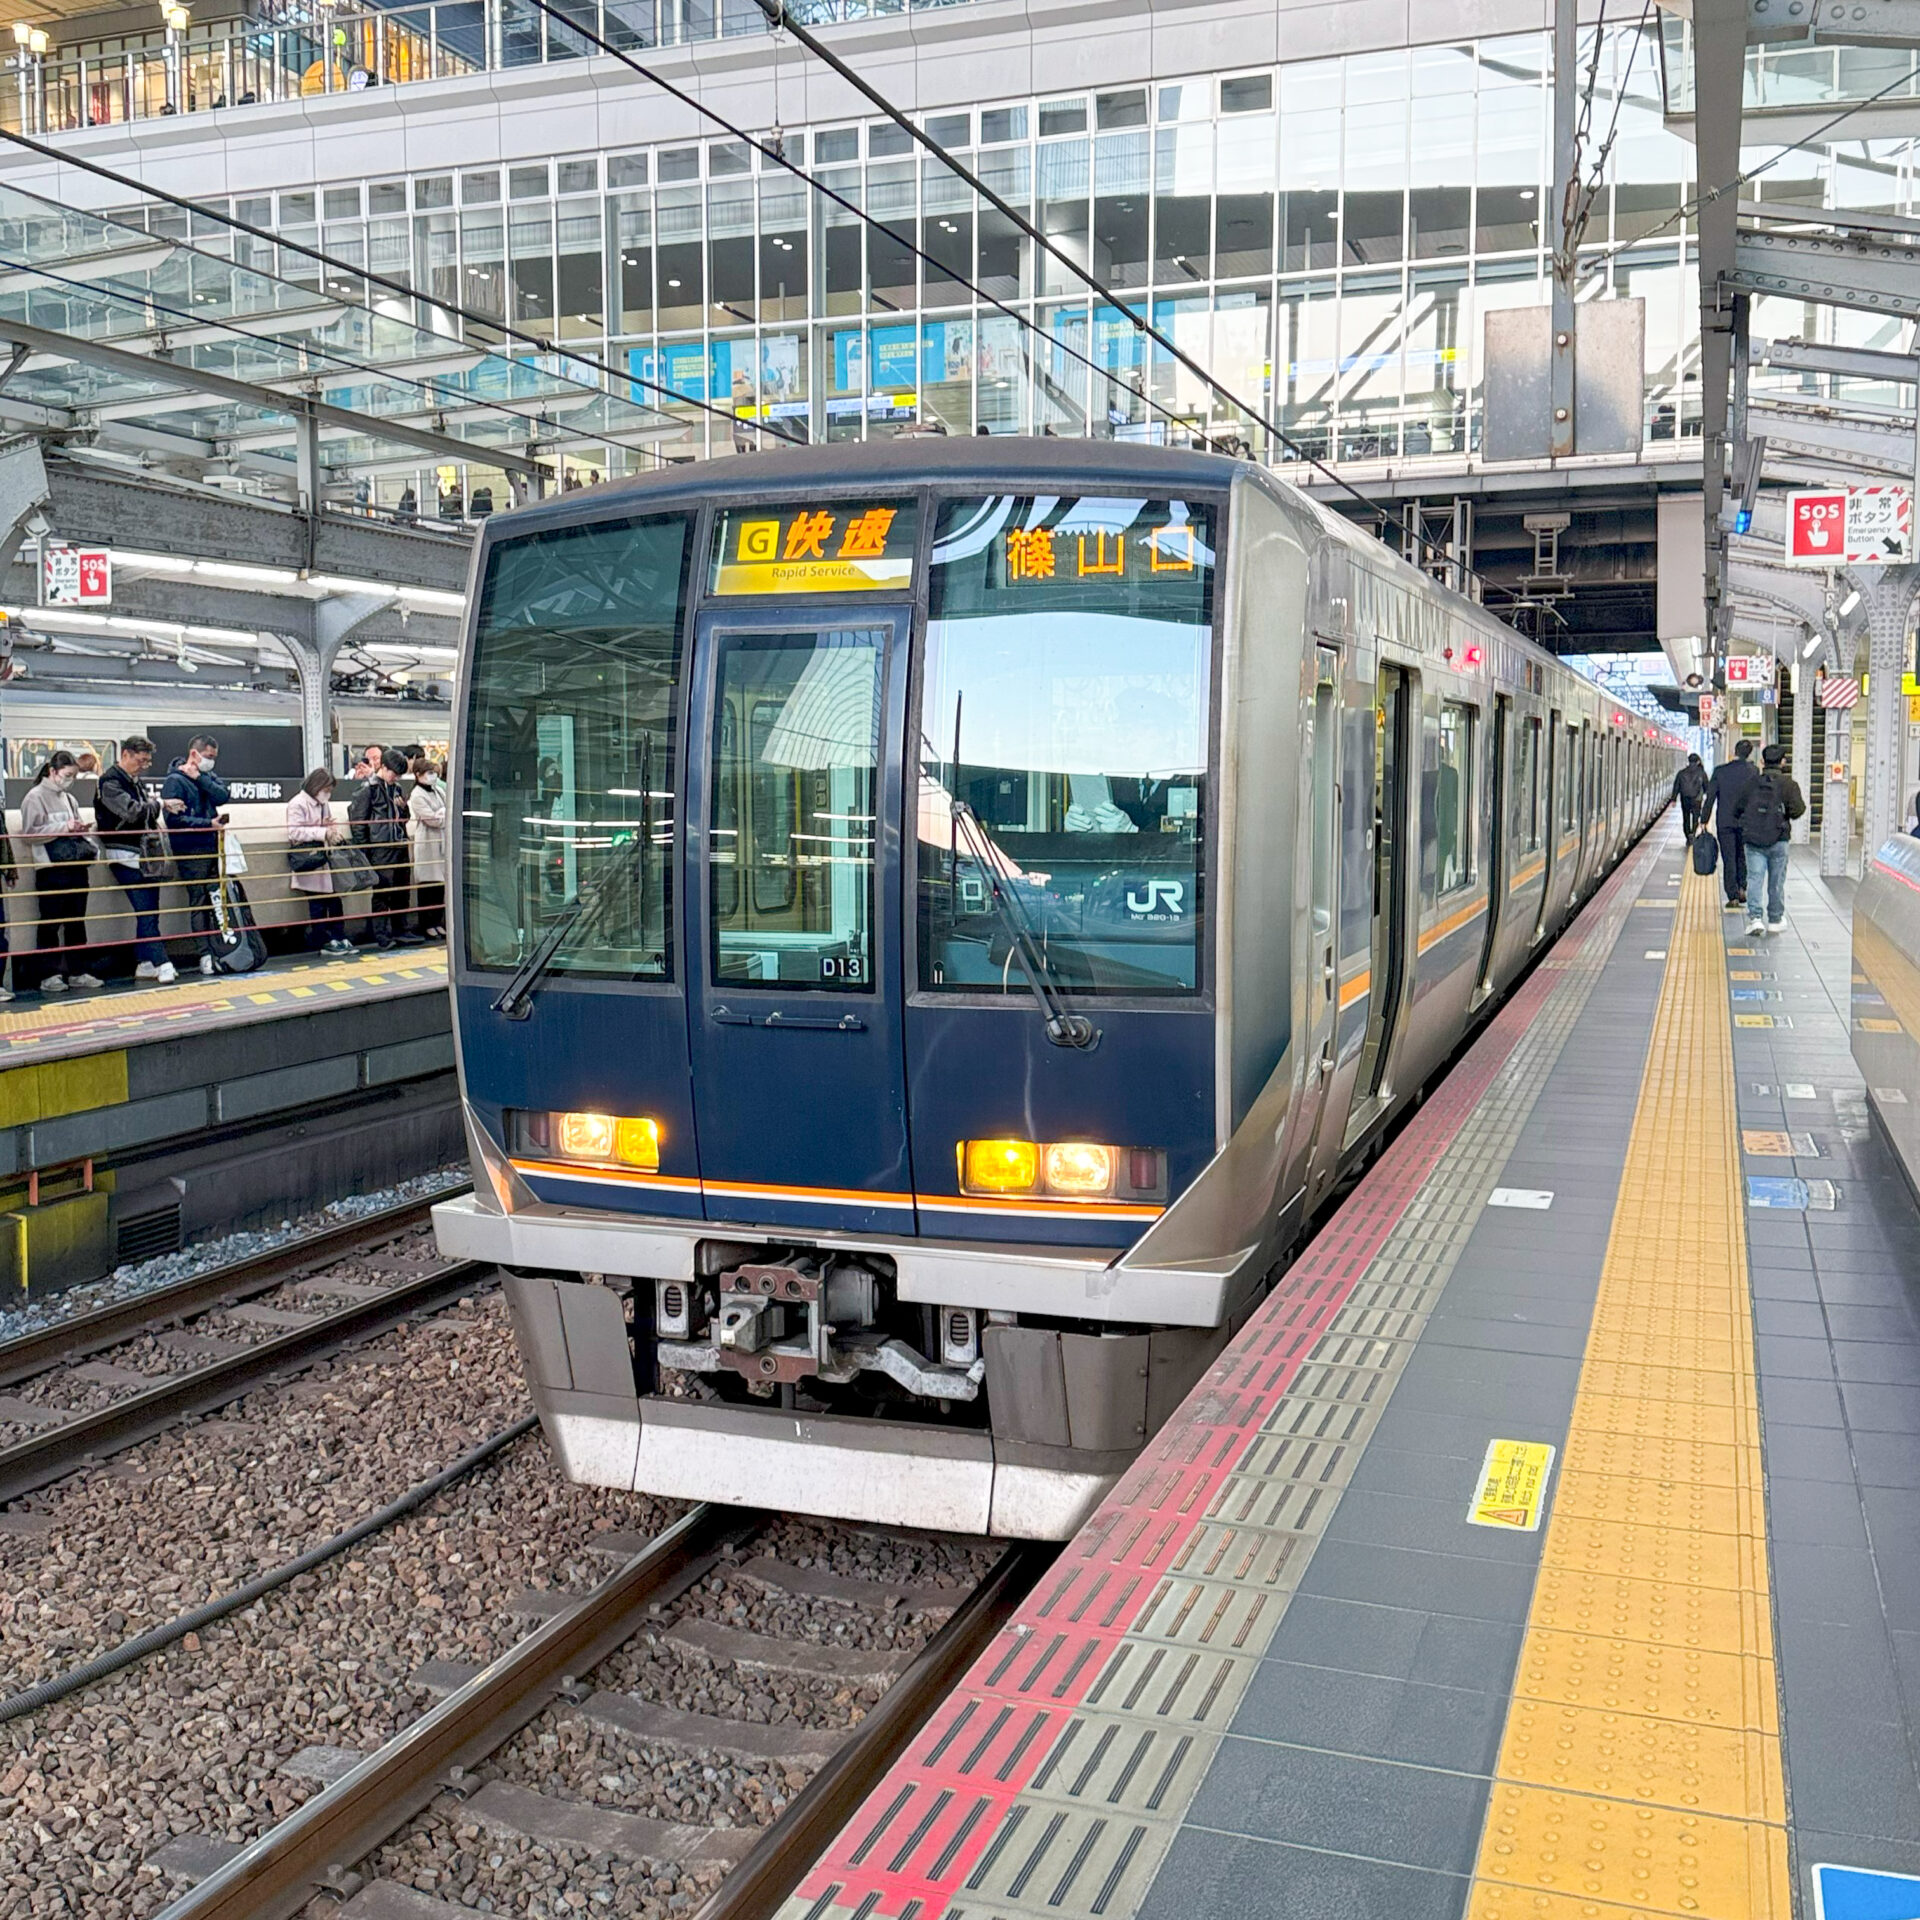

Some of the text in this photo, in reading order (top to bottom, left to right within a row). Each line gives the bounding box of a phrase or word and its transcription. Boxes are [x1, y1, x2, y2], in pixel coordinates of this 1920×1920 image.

[1799, 503, 1840, 520] SOS
[1849, 511, 1892, 525] ボタン
[783, 508, 898, 560] 快速
[1847, 526, 1892, 534] Emergency
[747, 528, 770, 554] G
[1847, 535, 1875, 543] Button
[82, 558, 106, 572] SOS
[772, 565, 855, 580] Rapid Service
[1127, 880, 1184, 913] JR
[823, 957, 860, 977] D13
